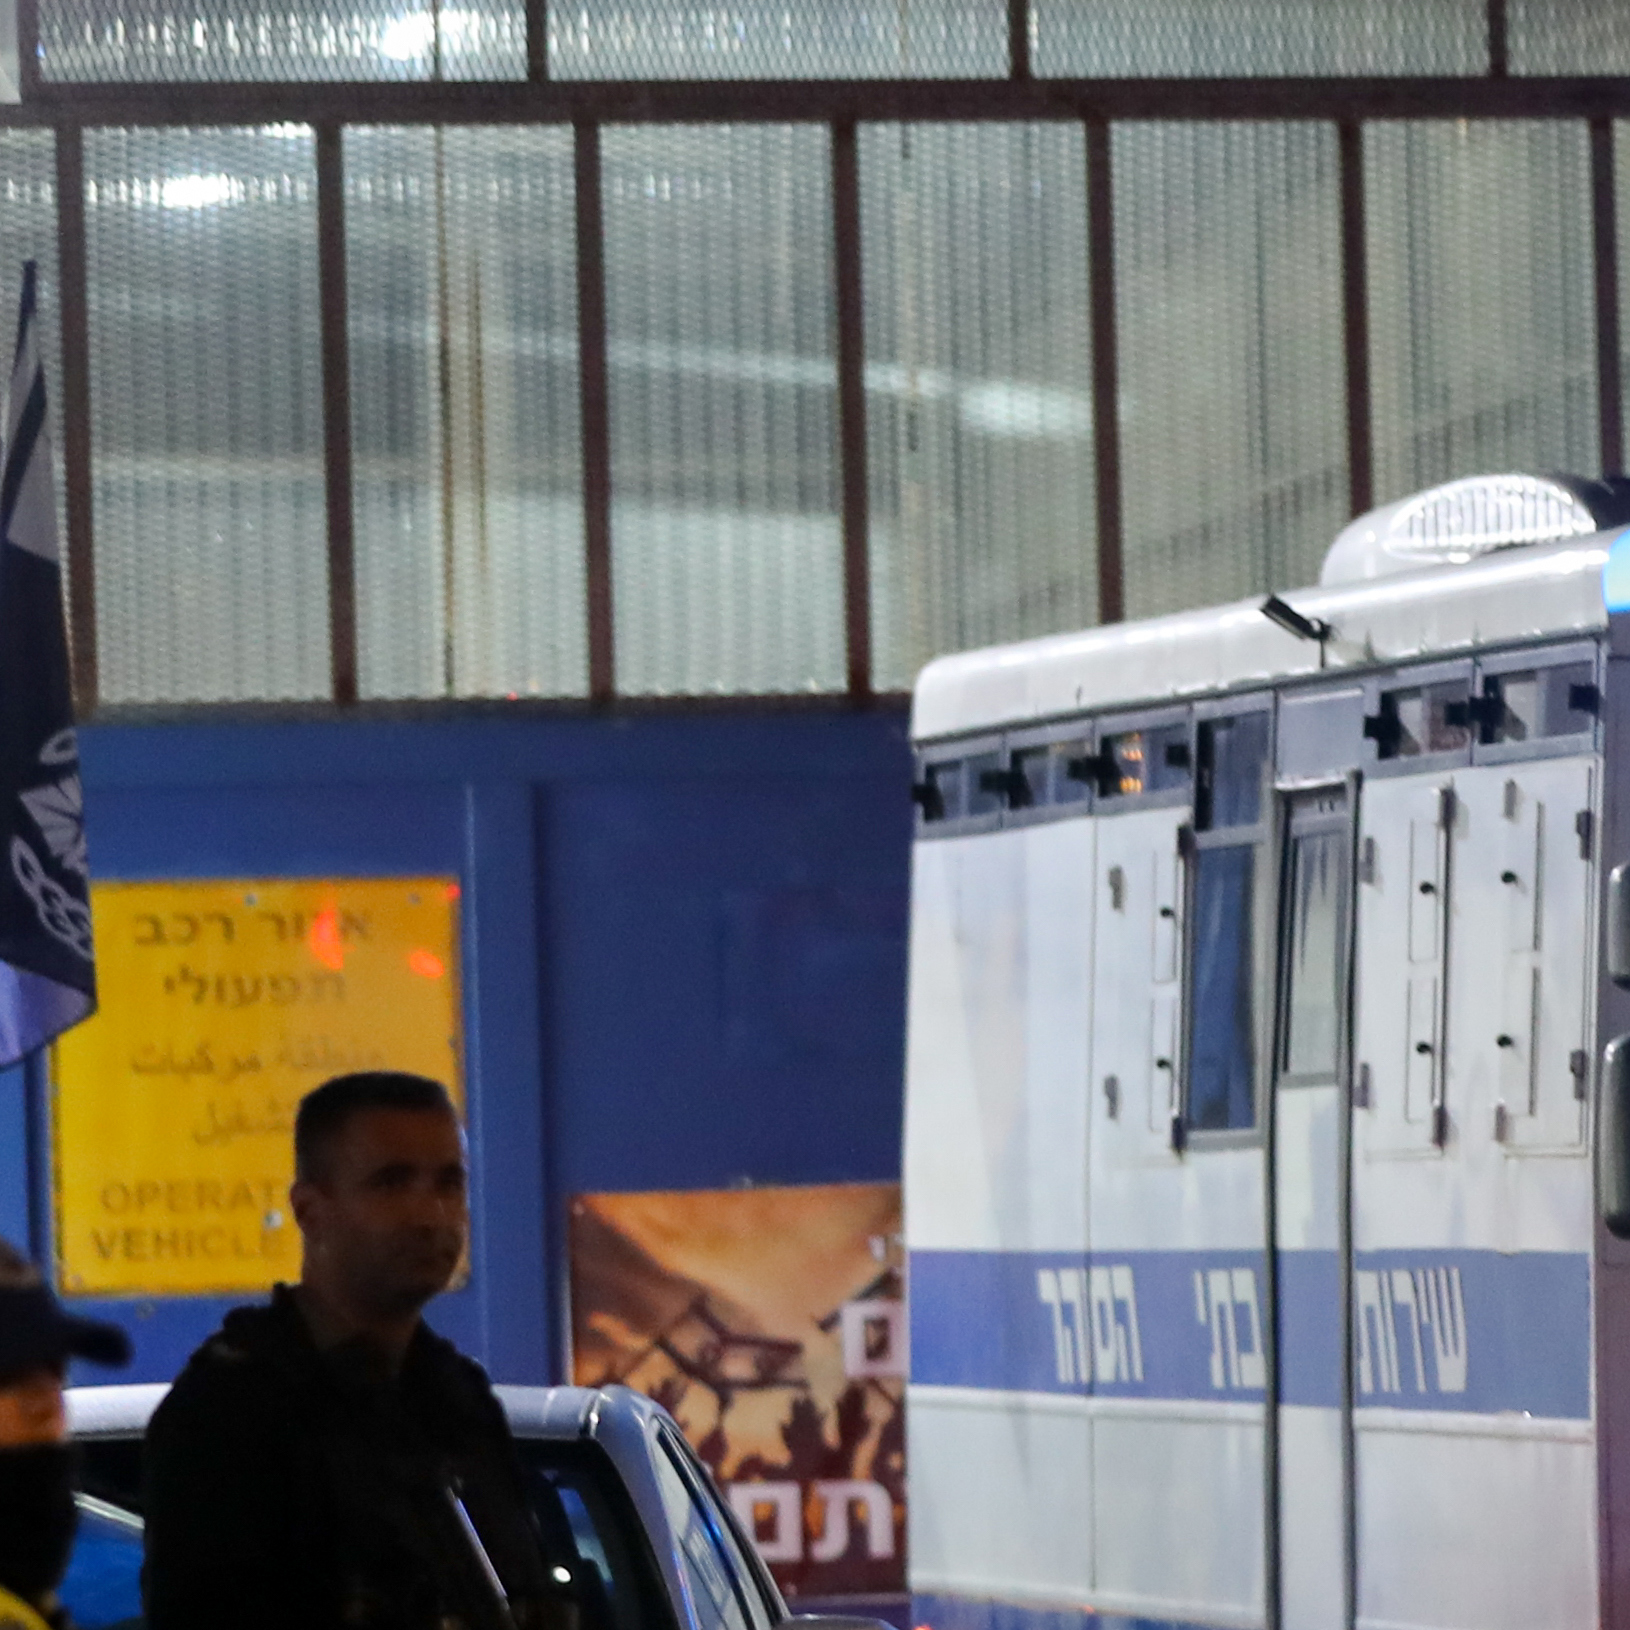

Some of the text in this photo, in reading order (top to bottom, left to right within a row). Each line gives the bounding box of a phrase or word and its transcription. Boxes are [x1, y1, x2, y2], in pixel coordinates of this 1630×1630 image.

[133, 911, 372, 946] אור רכב
[1195, 1268, 1266, 1389] בתי
[1358, 1267, 1467, 1393] שירות
